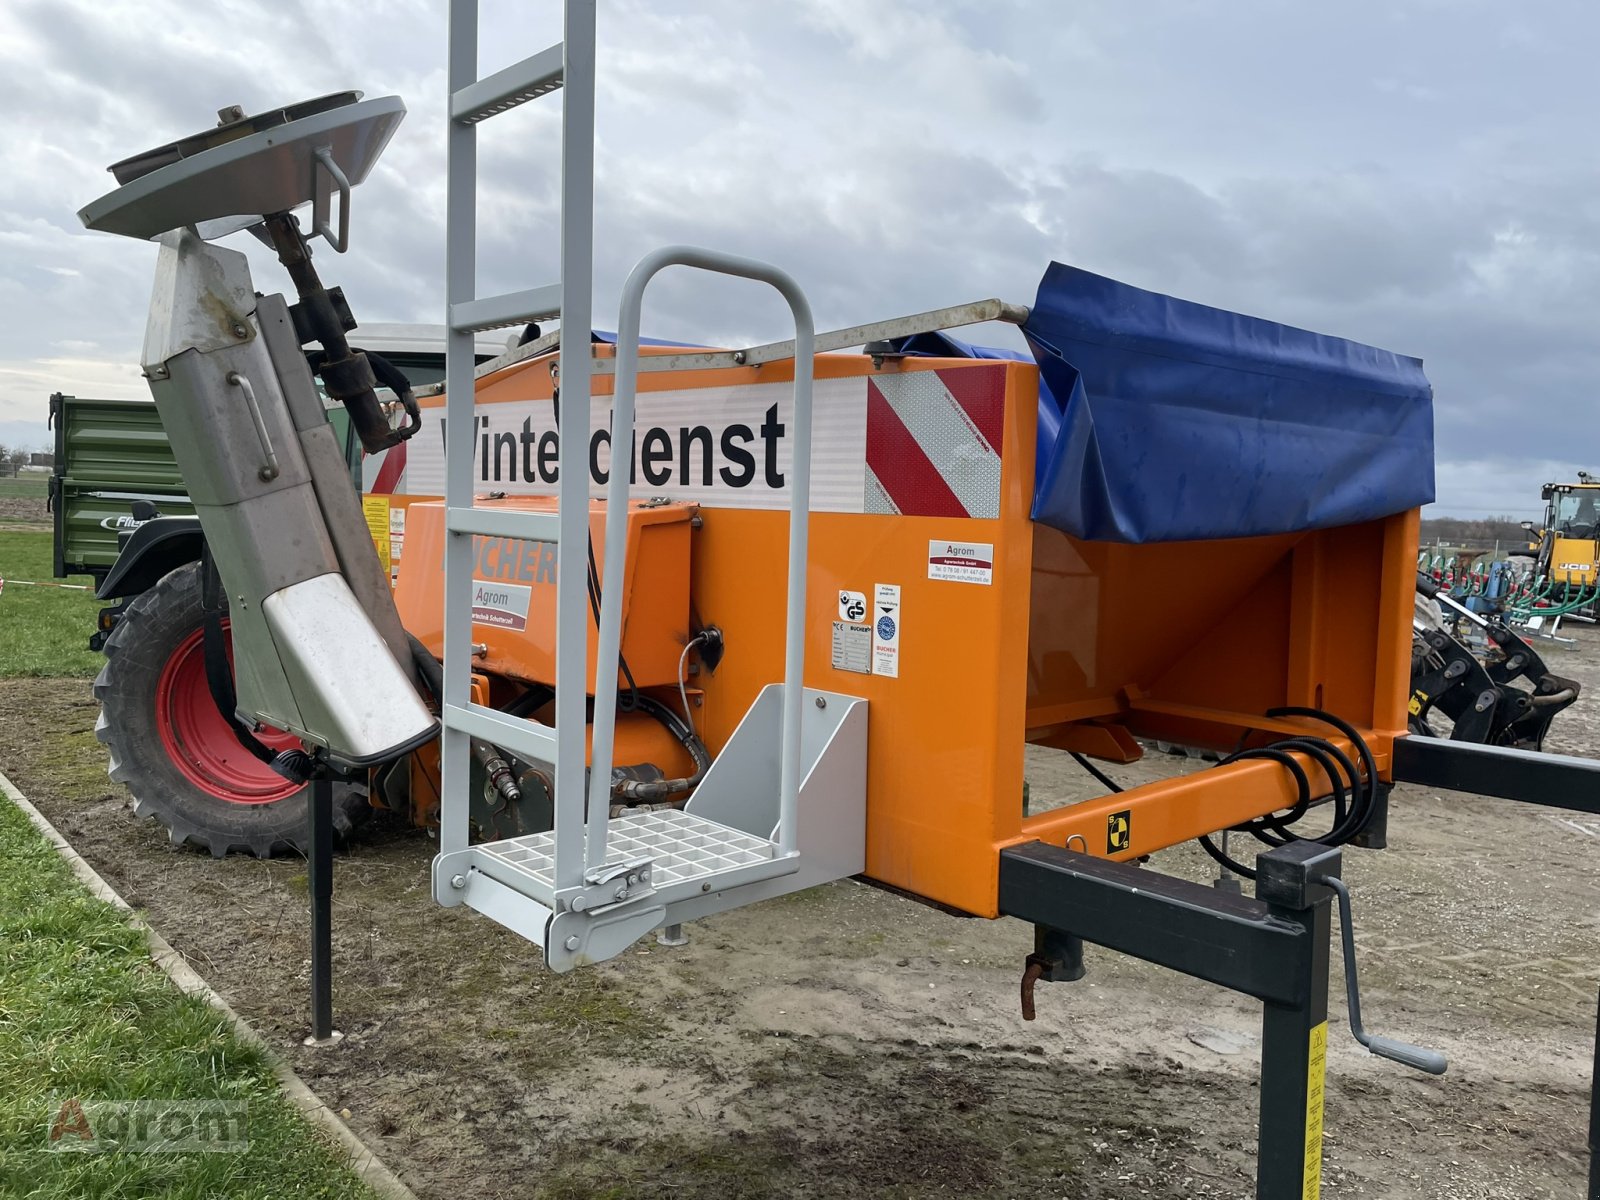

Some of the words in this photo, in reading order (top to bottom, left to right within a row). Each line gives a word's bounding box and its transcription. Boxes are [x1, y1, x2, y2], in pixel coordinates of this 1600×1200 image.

[440, 402, 785, 488] intedenst
[116, 516, 147, 528] Flie
[946, 545, 974, 555] Agrom
[441, 535, 557, 584] CHER
[1559, 563, 1590, 571] JCB
[476, 587, 508, 606] Agrom
[847, 601, 865, 620] GS
[876, 645, 896, 653] BUCHER
[1109, 816, 1115, 824] S
